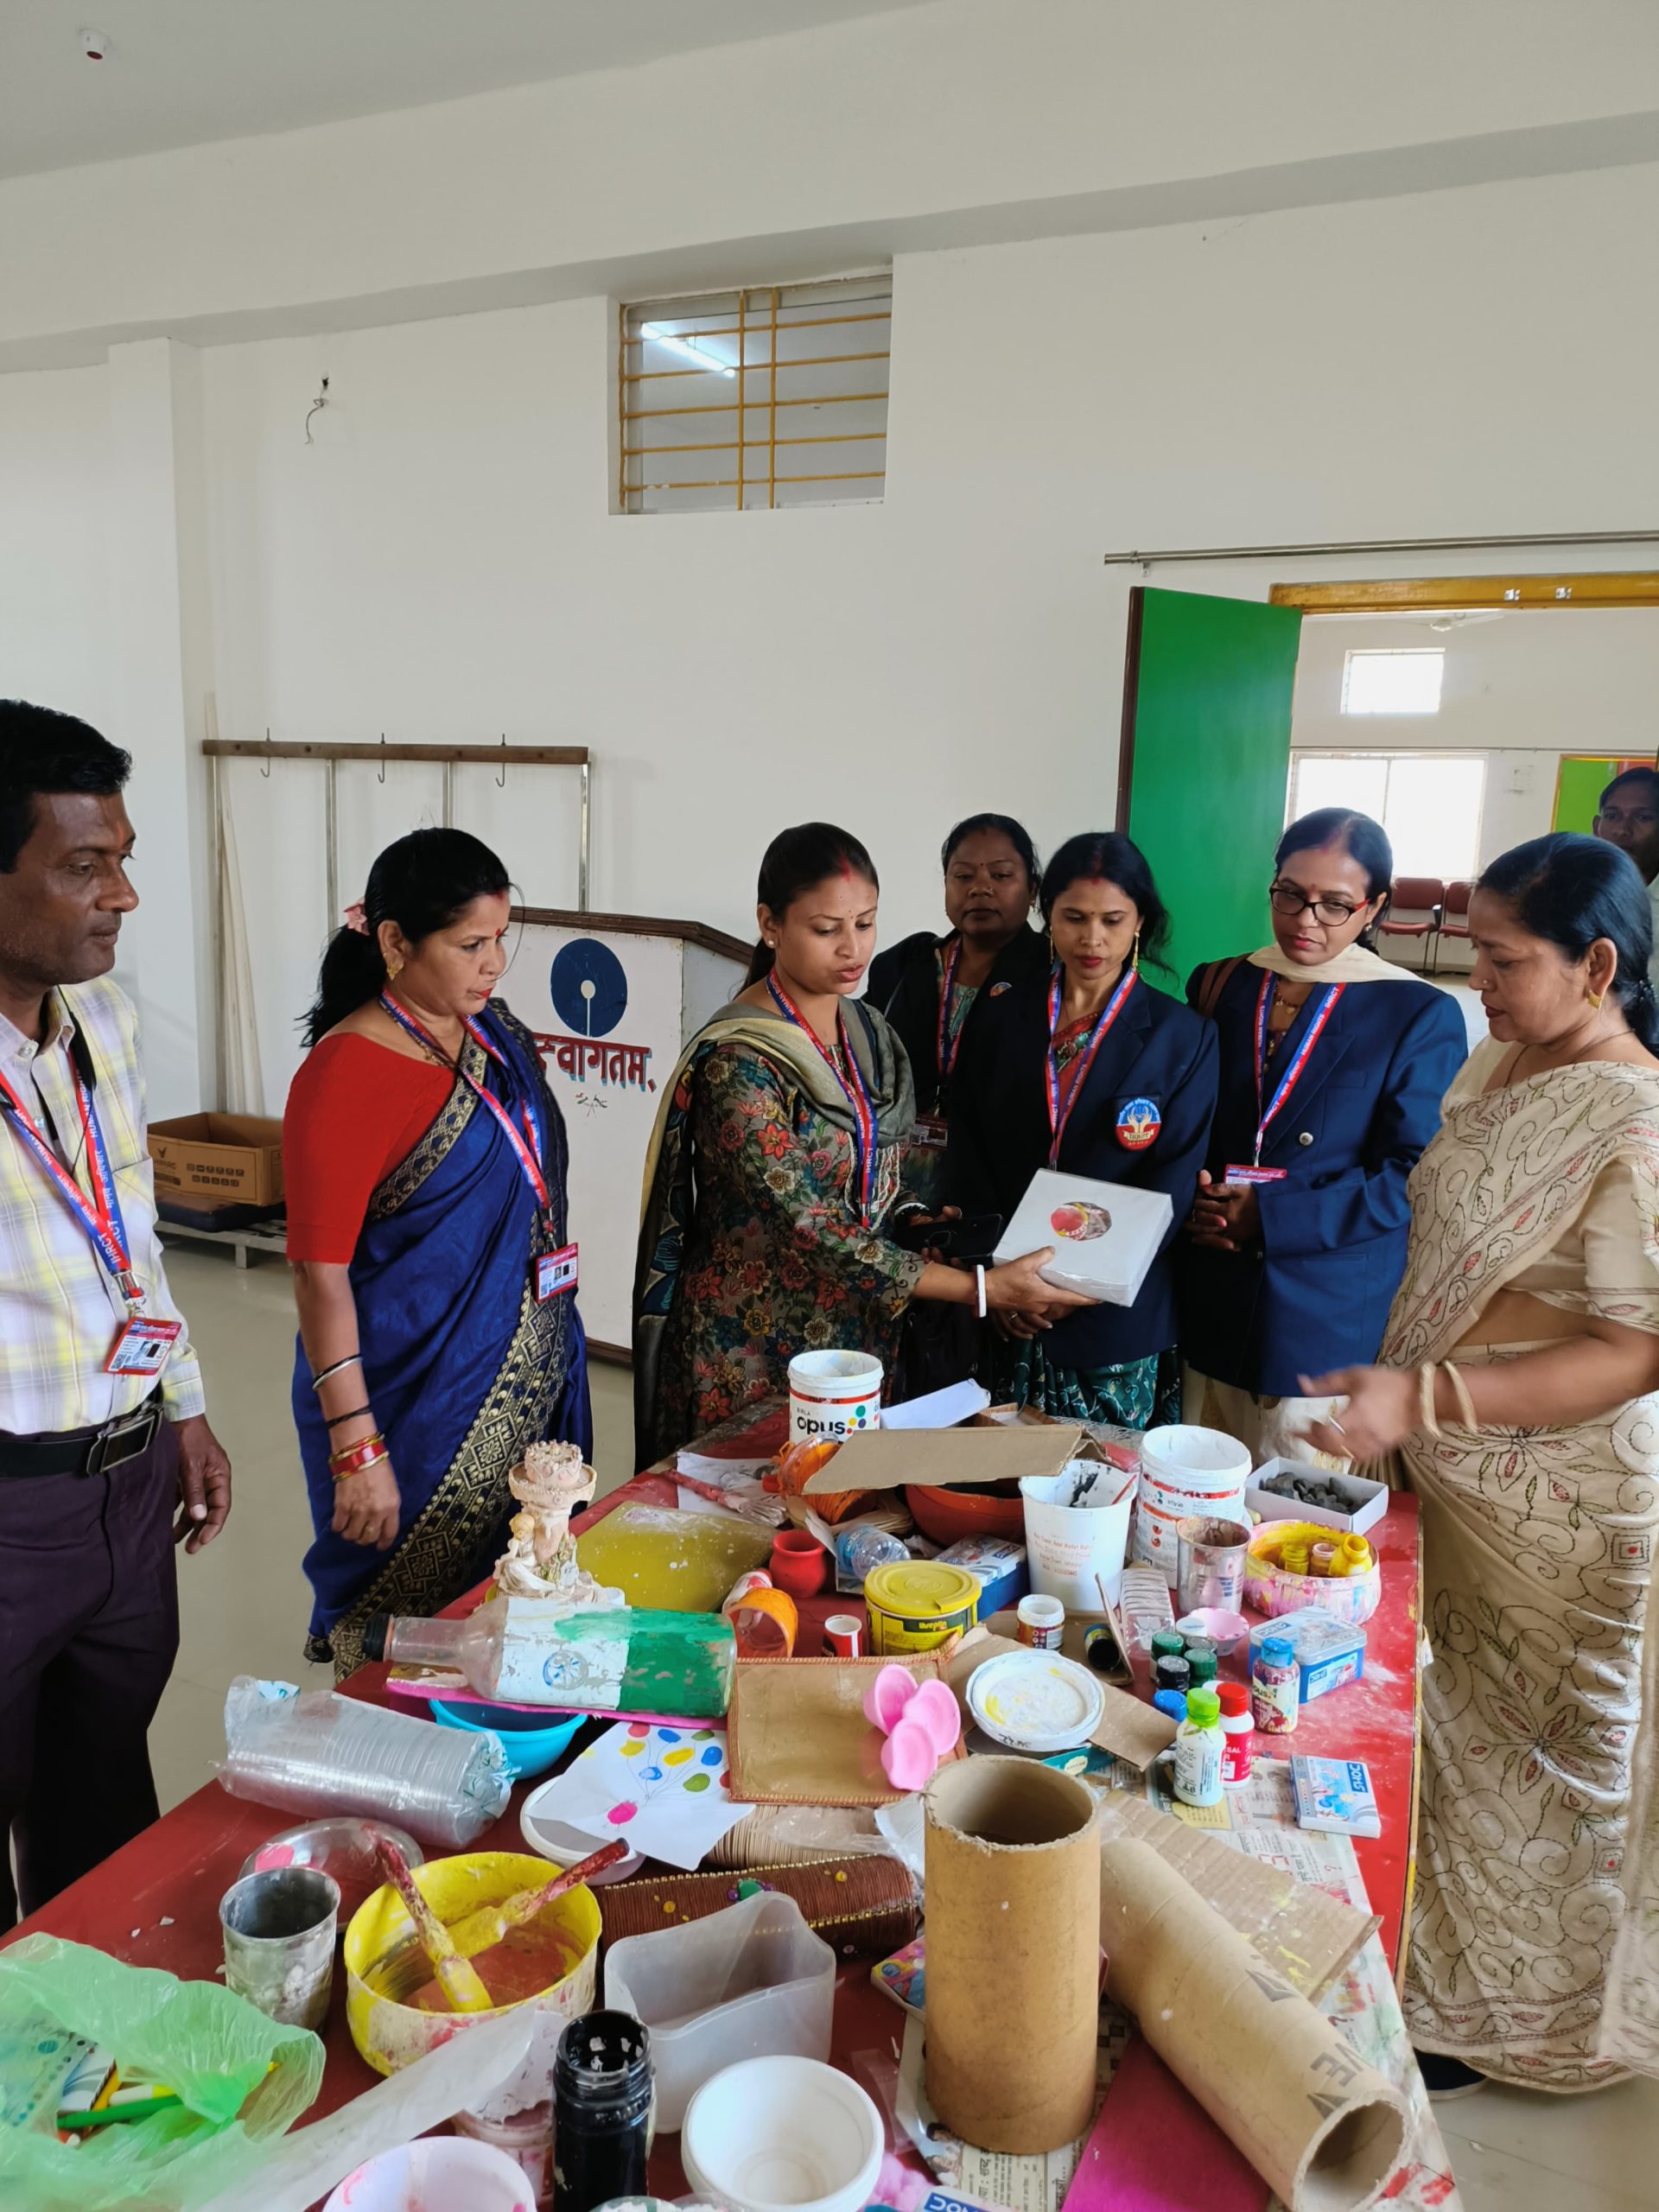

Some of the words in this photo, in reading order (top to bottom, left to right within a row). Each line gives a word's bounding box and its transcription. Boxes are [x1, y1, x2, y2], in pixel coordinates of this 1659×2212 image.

[778, 992, 796, 1014] HUMAN
[395, 1005, 416, 1028] HUMAN
[1299, 1033, 1315, 1056] HUMAN
[1310, 1012, 1325, 1034] RIGHTS
[1324, 986, 1339, 1008] IHRCT
[1064, 1083, 1080, 1106] HUMAN
[1089, 1027, 1104, 1049] IHRCT
[864, 1147, 874, 1173] IHRCT
[94, 1230, 124, 1265] IHRCT
[797, 1407, 810, 1416] BIRLA
[797, 1416, 846, 1434] opus
[918, 1620, 947, 1631] threptin
